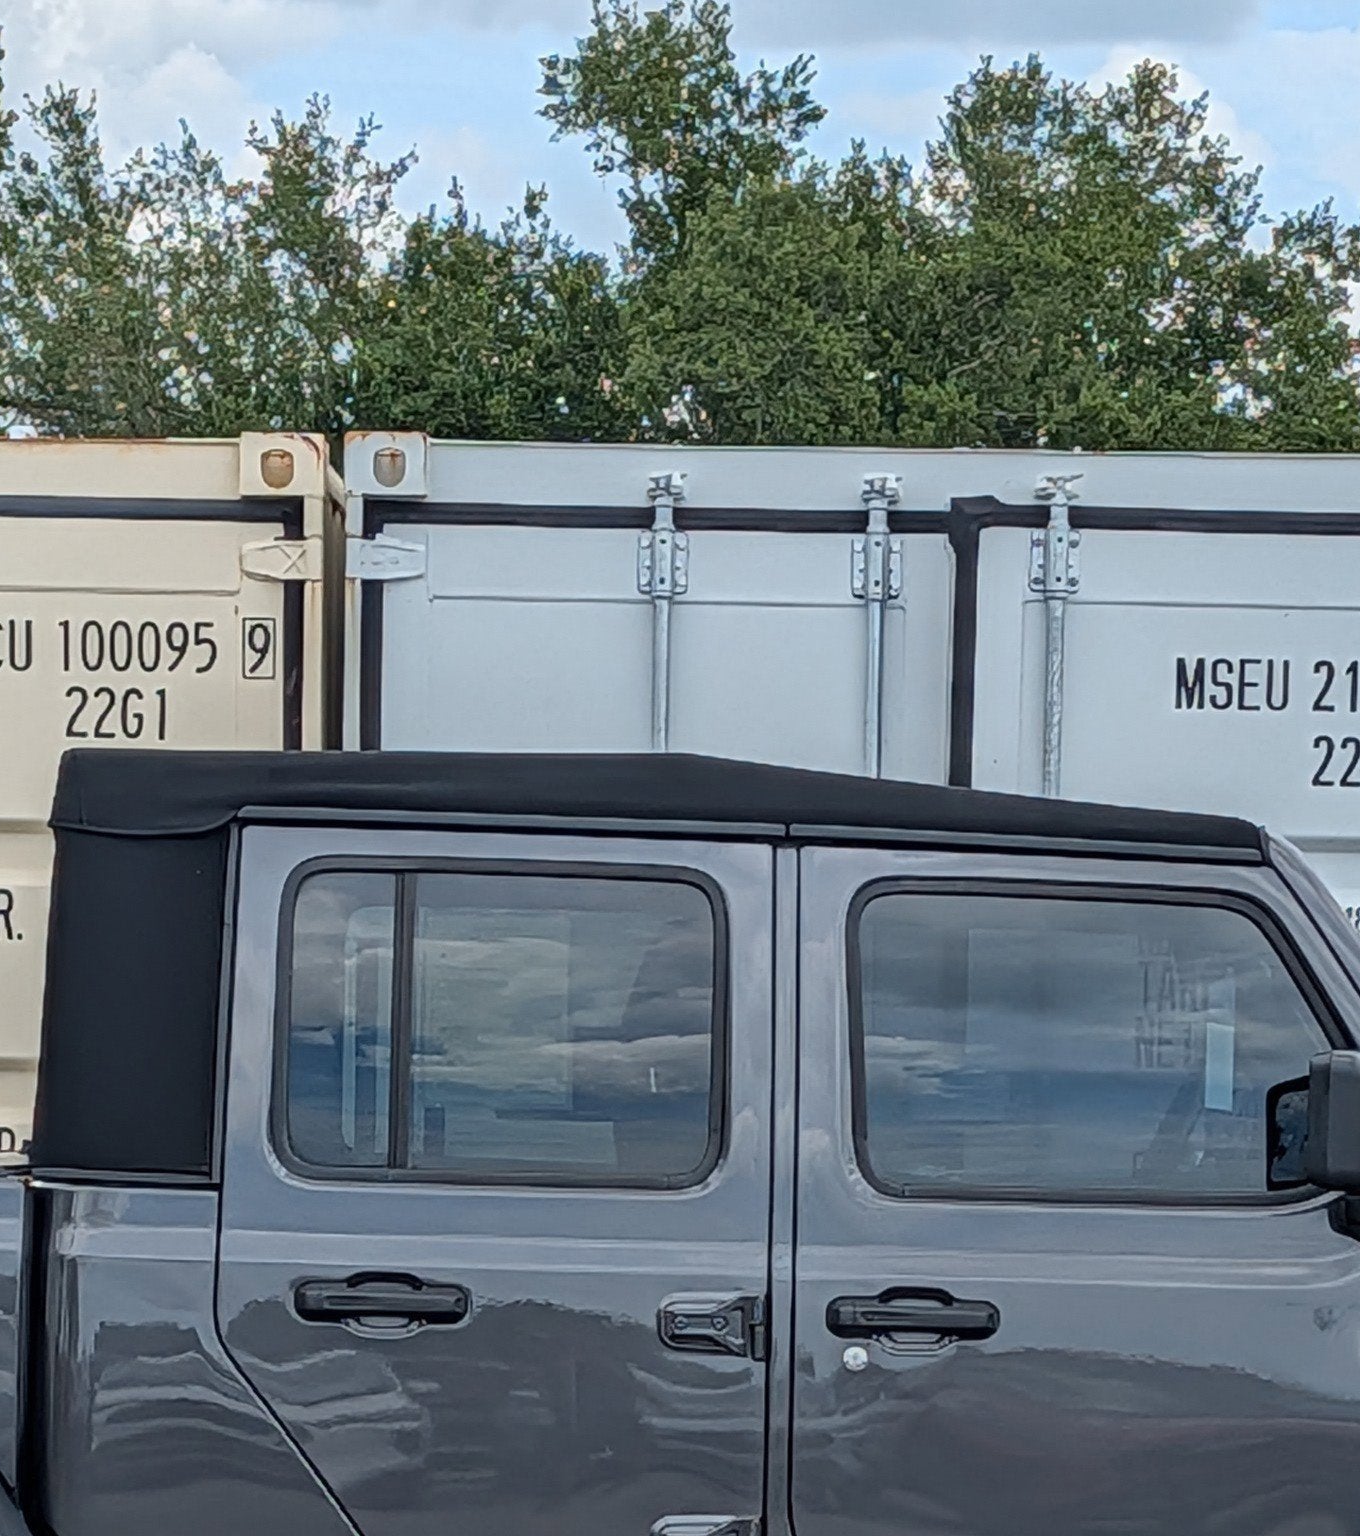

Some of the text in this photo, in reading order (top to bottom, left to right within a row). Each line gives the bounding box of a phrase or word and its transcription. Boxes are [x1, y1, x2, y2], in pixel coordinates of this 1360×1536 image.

[58, 619, 218, 674] 100095
[247, 623, 272, 674] 9
[1174, 657, 1291, 712] MSEU
[65, 686, 167, 741] 22G1
